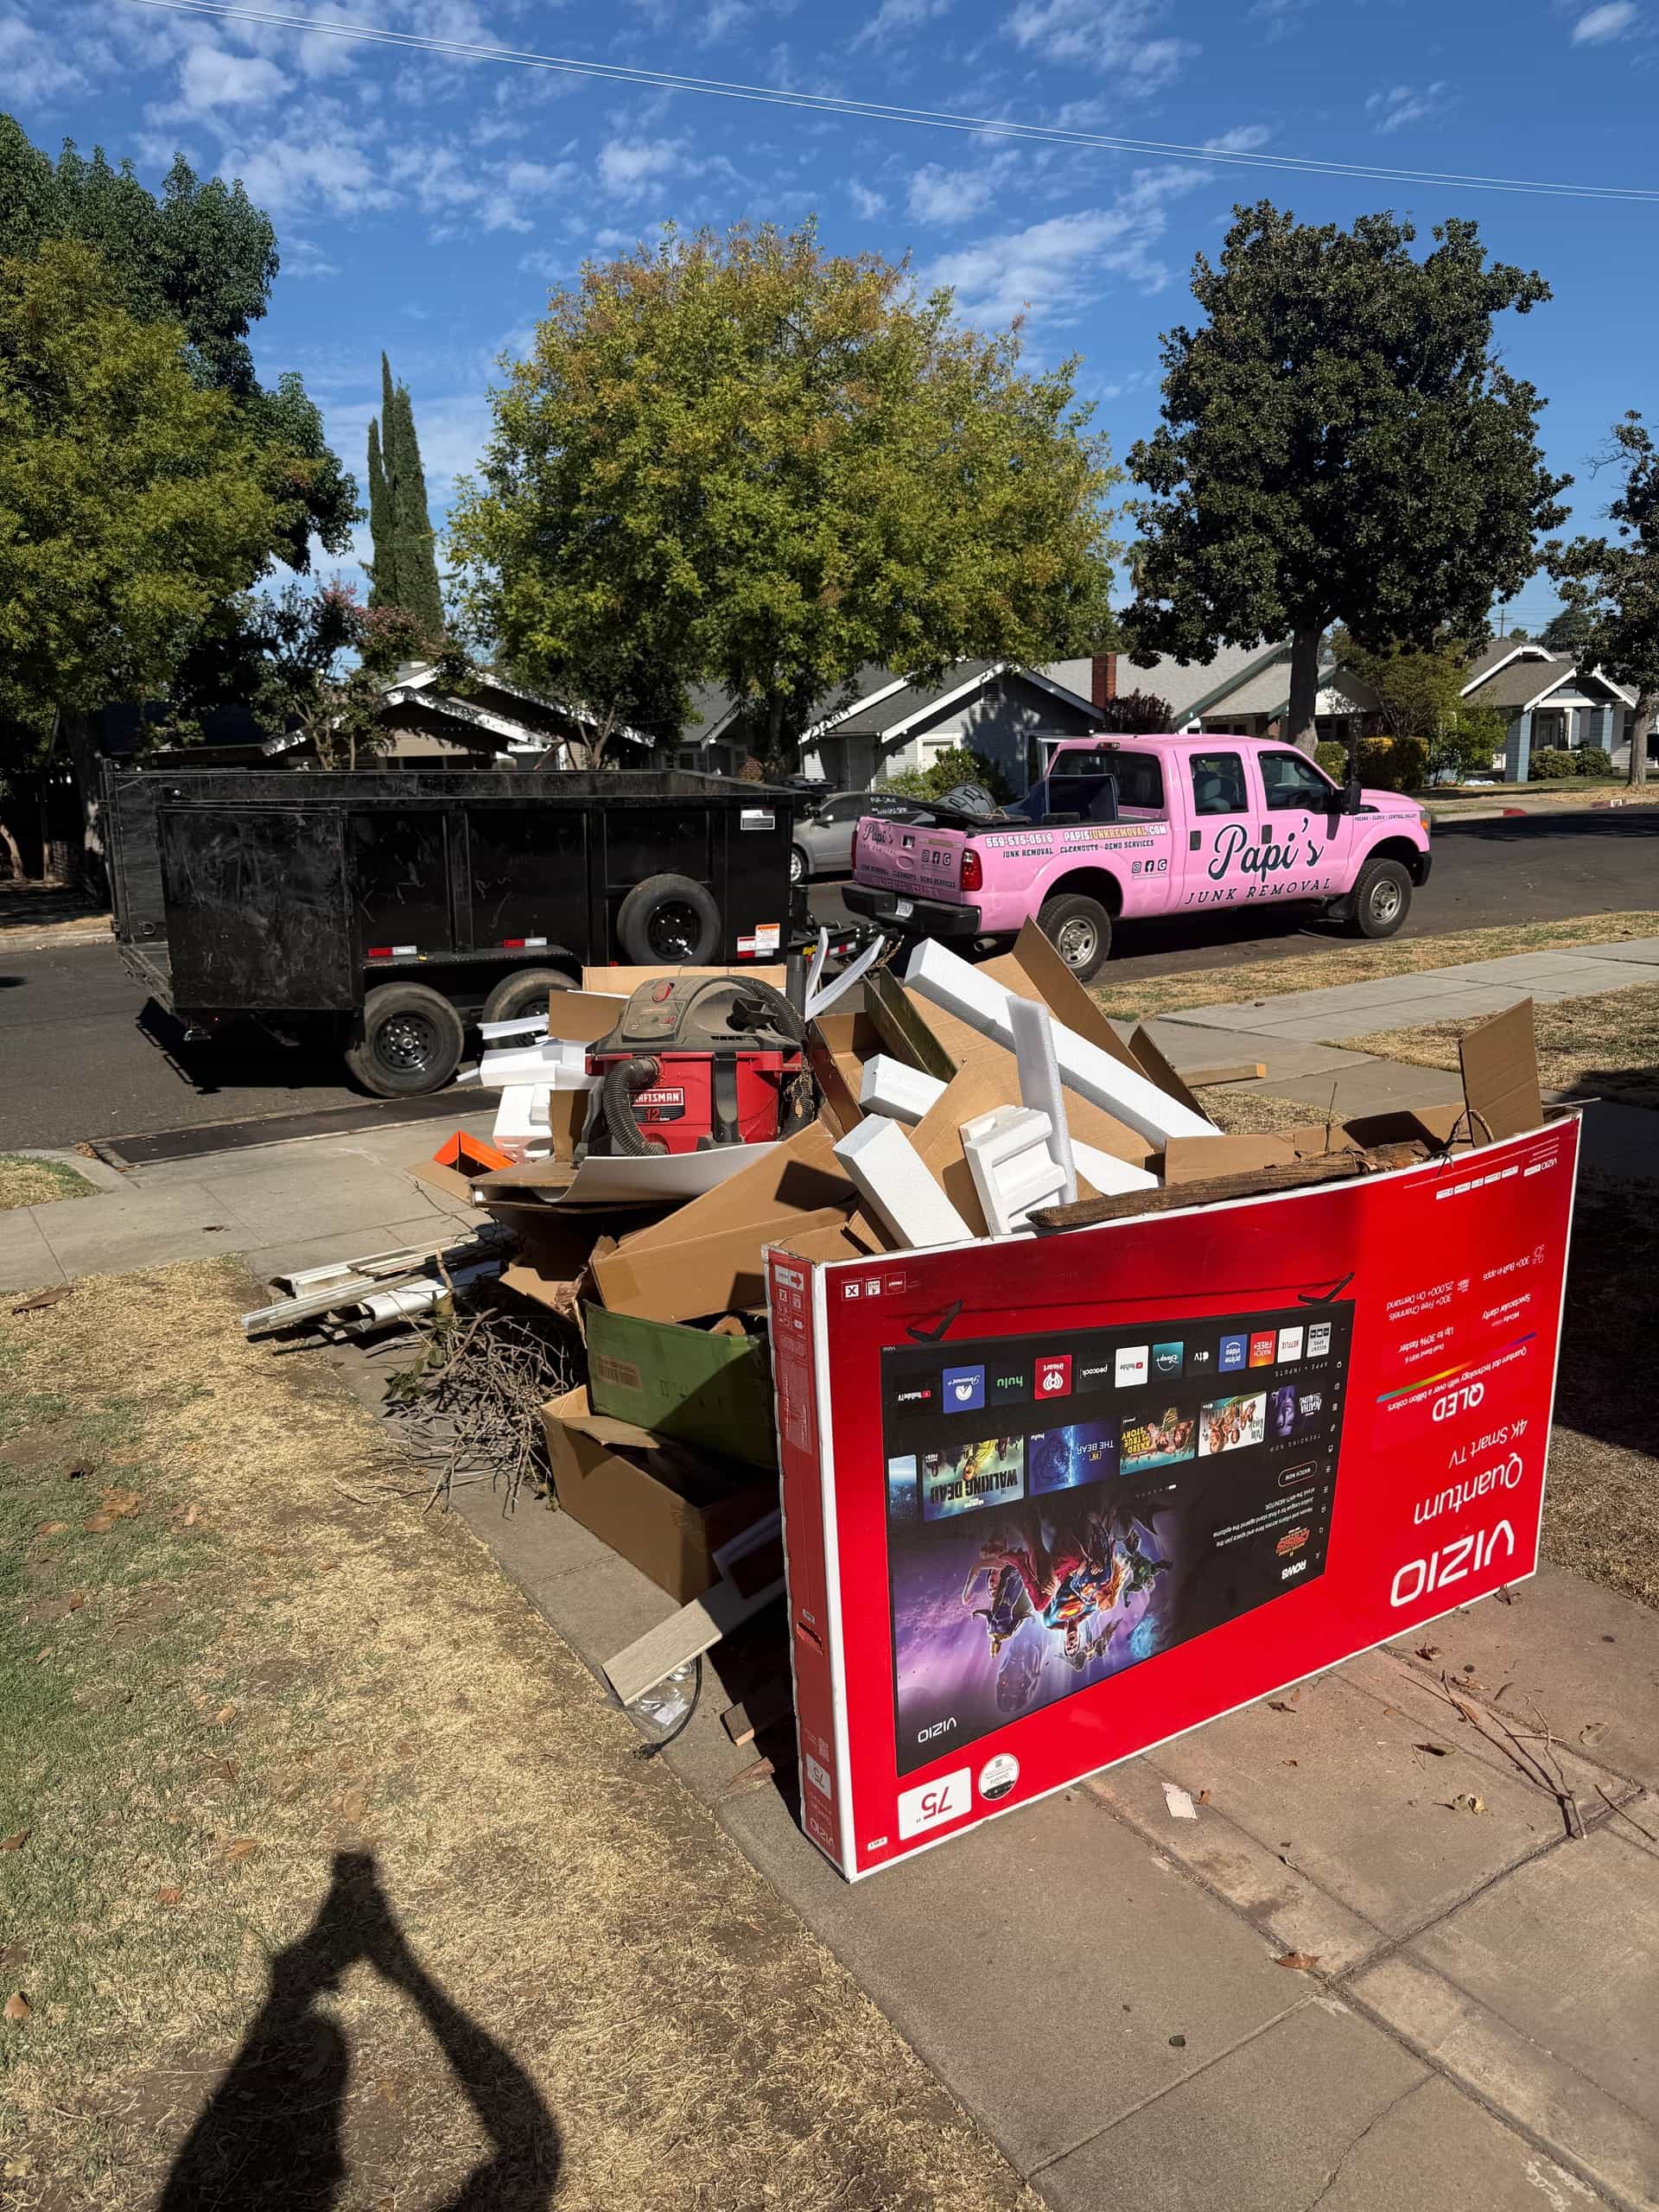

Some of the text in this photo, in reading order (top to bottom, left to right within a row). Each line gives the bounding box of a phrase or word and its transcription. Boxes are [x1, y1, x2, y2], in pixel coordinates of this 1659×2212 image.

[985, 825, 1167, 848] 559-575-0516 PAPISJUNKREMOVAL.COM
[1003, 840, 1154, 858] JUNK REMOVAL CLEANOUTS DEMO SERVICES
[1208, 817, 1325, 883] Papi's
[1185, 877, 1332, 905] JUNK REMOVAL
[635, 1092, 680, 1103] AFTSMAN
[646, 1108, 660, 1122] 12
[1516, 1255, 1529, 1268] 300+
[1483, 1270, 1497, 1281] apps
[1416, 1291, 1427, 1300] On
[1386, 1294, 1415, 1312] Demand
[1389, 1294, 1452, 1322] 300+ Free Channels
[1481, 1294, 1531, 1320] Spectacular clarity
[1281, 1340, 1299, 1350] NETFLIX
[1396, 1326, 1454, 1356] Up to 30% faster
[1225, 1347, 1241, 1357] video
[1253, 1348, 1272, 1357] WATCH
[1502, 1346, 1527, 1364] Quantum
[1155, 1354, 1179, 1366] Disney+
[1224, 1354, 1241, 1364] prime
[1492, 1358, 1502, 1370] dot
[1043, 1363, 1064, 1372] iHeart
[1083, 1364, 1107, 1377] peacock
[1274, 1361, 1327, 1377] APPS INPUTS
[1460, 1363, 1491, 1382] technology
[947, 1375, 981, 1386] Paramount+
[996, 1376, 1023, 1389] hulu
[1447, 1378, 1459, 1389] with
[1433, 1382, 1447, 1394] over
[1408, 1390, 1427, 1404] billion
[1433, 1382, 1484, 1421] QLED
[1388, 1398, 1408, 1411] colors
[1031, 1433, 1045, 1441] hulu
[1121, 1427, 1144, 1440] STORY
[1077, 1440, 1115, 1455] THE BEAR
[1124, 1435, 1141, 1447] TRUE
[1127, 1440, 1150, 1453] BASED
[1269, 1433, 1320, 1452] TRENDING NOW
[1447, 1419, 1529, 1470] 4K Smart TV
[1285, 1472, 1296, 1481] NOW
[930, 1469, 1018, 1504] WALKING DEAD
[1414, 1452, 1522, 1525] Quantum
[1240, 1518, 1255, 1529] against
[1256, 1515, 1268, 1523] stand
[1212, 1526, 1231, 1537] epitome
[1234, 1532, 1246, 1541] space
[1390, 1520, 1514, 1608] VIZIO
[918, 1718, 957, 1744] VIZIO
